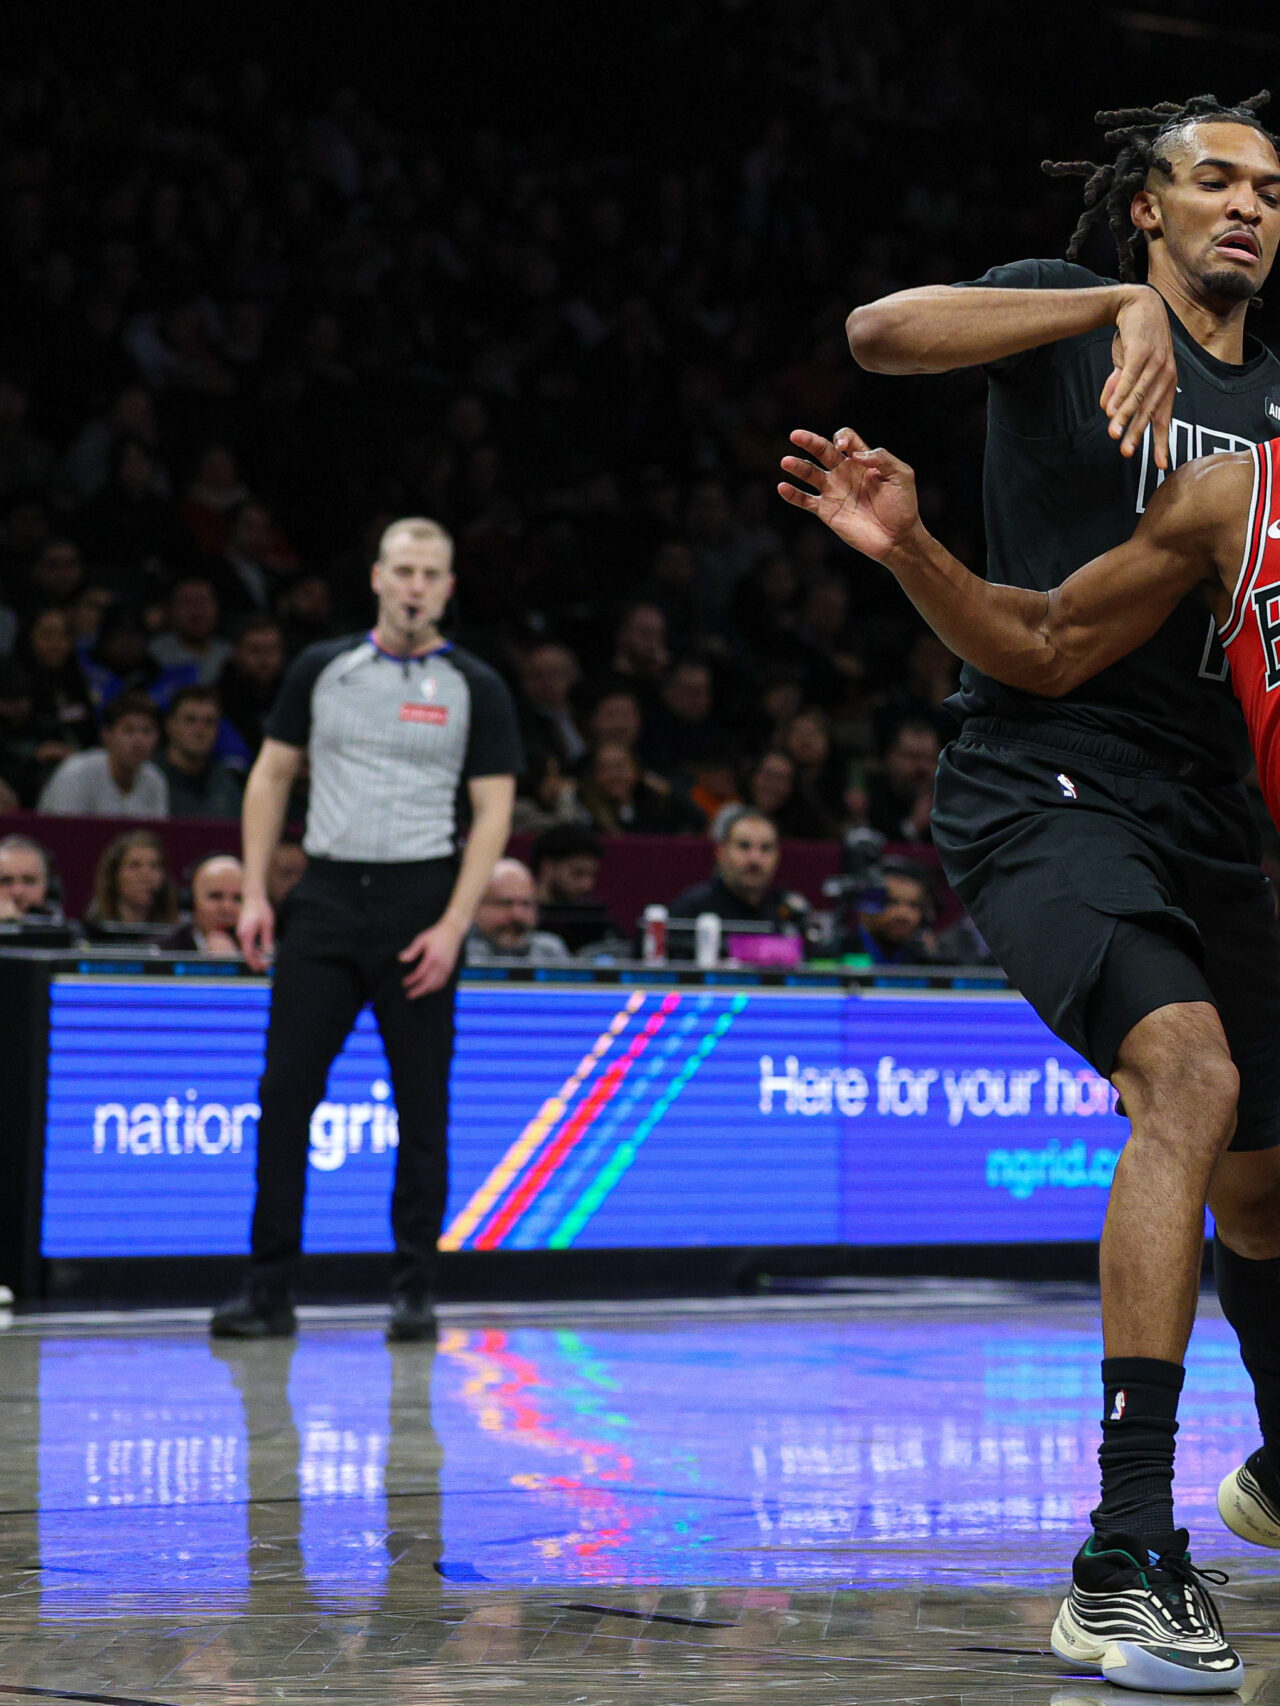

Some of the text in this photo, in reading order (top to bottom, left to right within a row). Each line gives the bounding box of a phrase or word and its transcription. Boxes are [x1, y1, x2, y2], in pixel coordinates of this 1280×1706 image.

[1269, 403, 1280, 420] All
[759, 1054, 869, 1117] Here
[876, 1054, 940, 1117] for
[942, 1067, 1042, 1127] your
